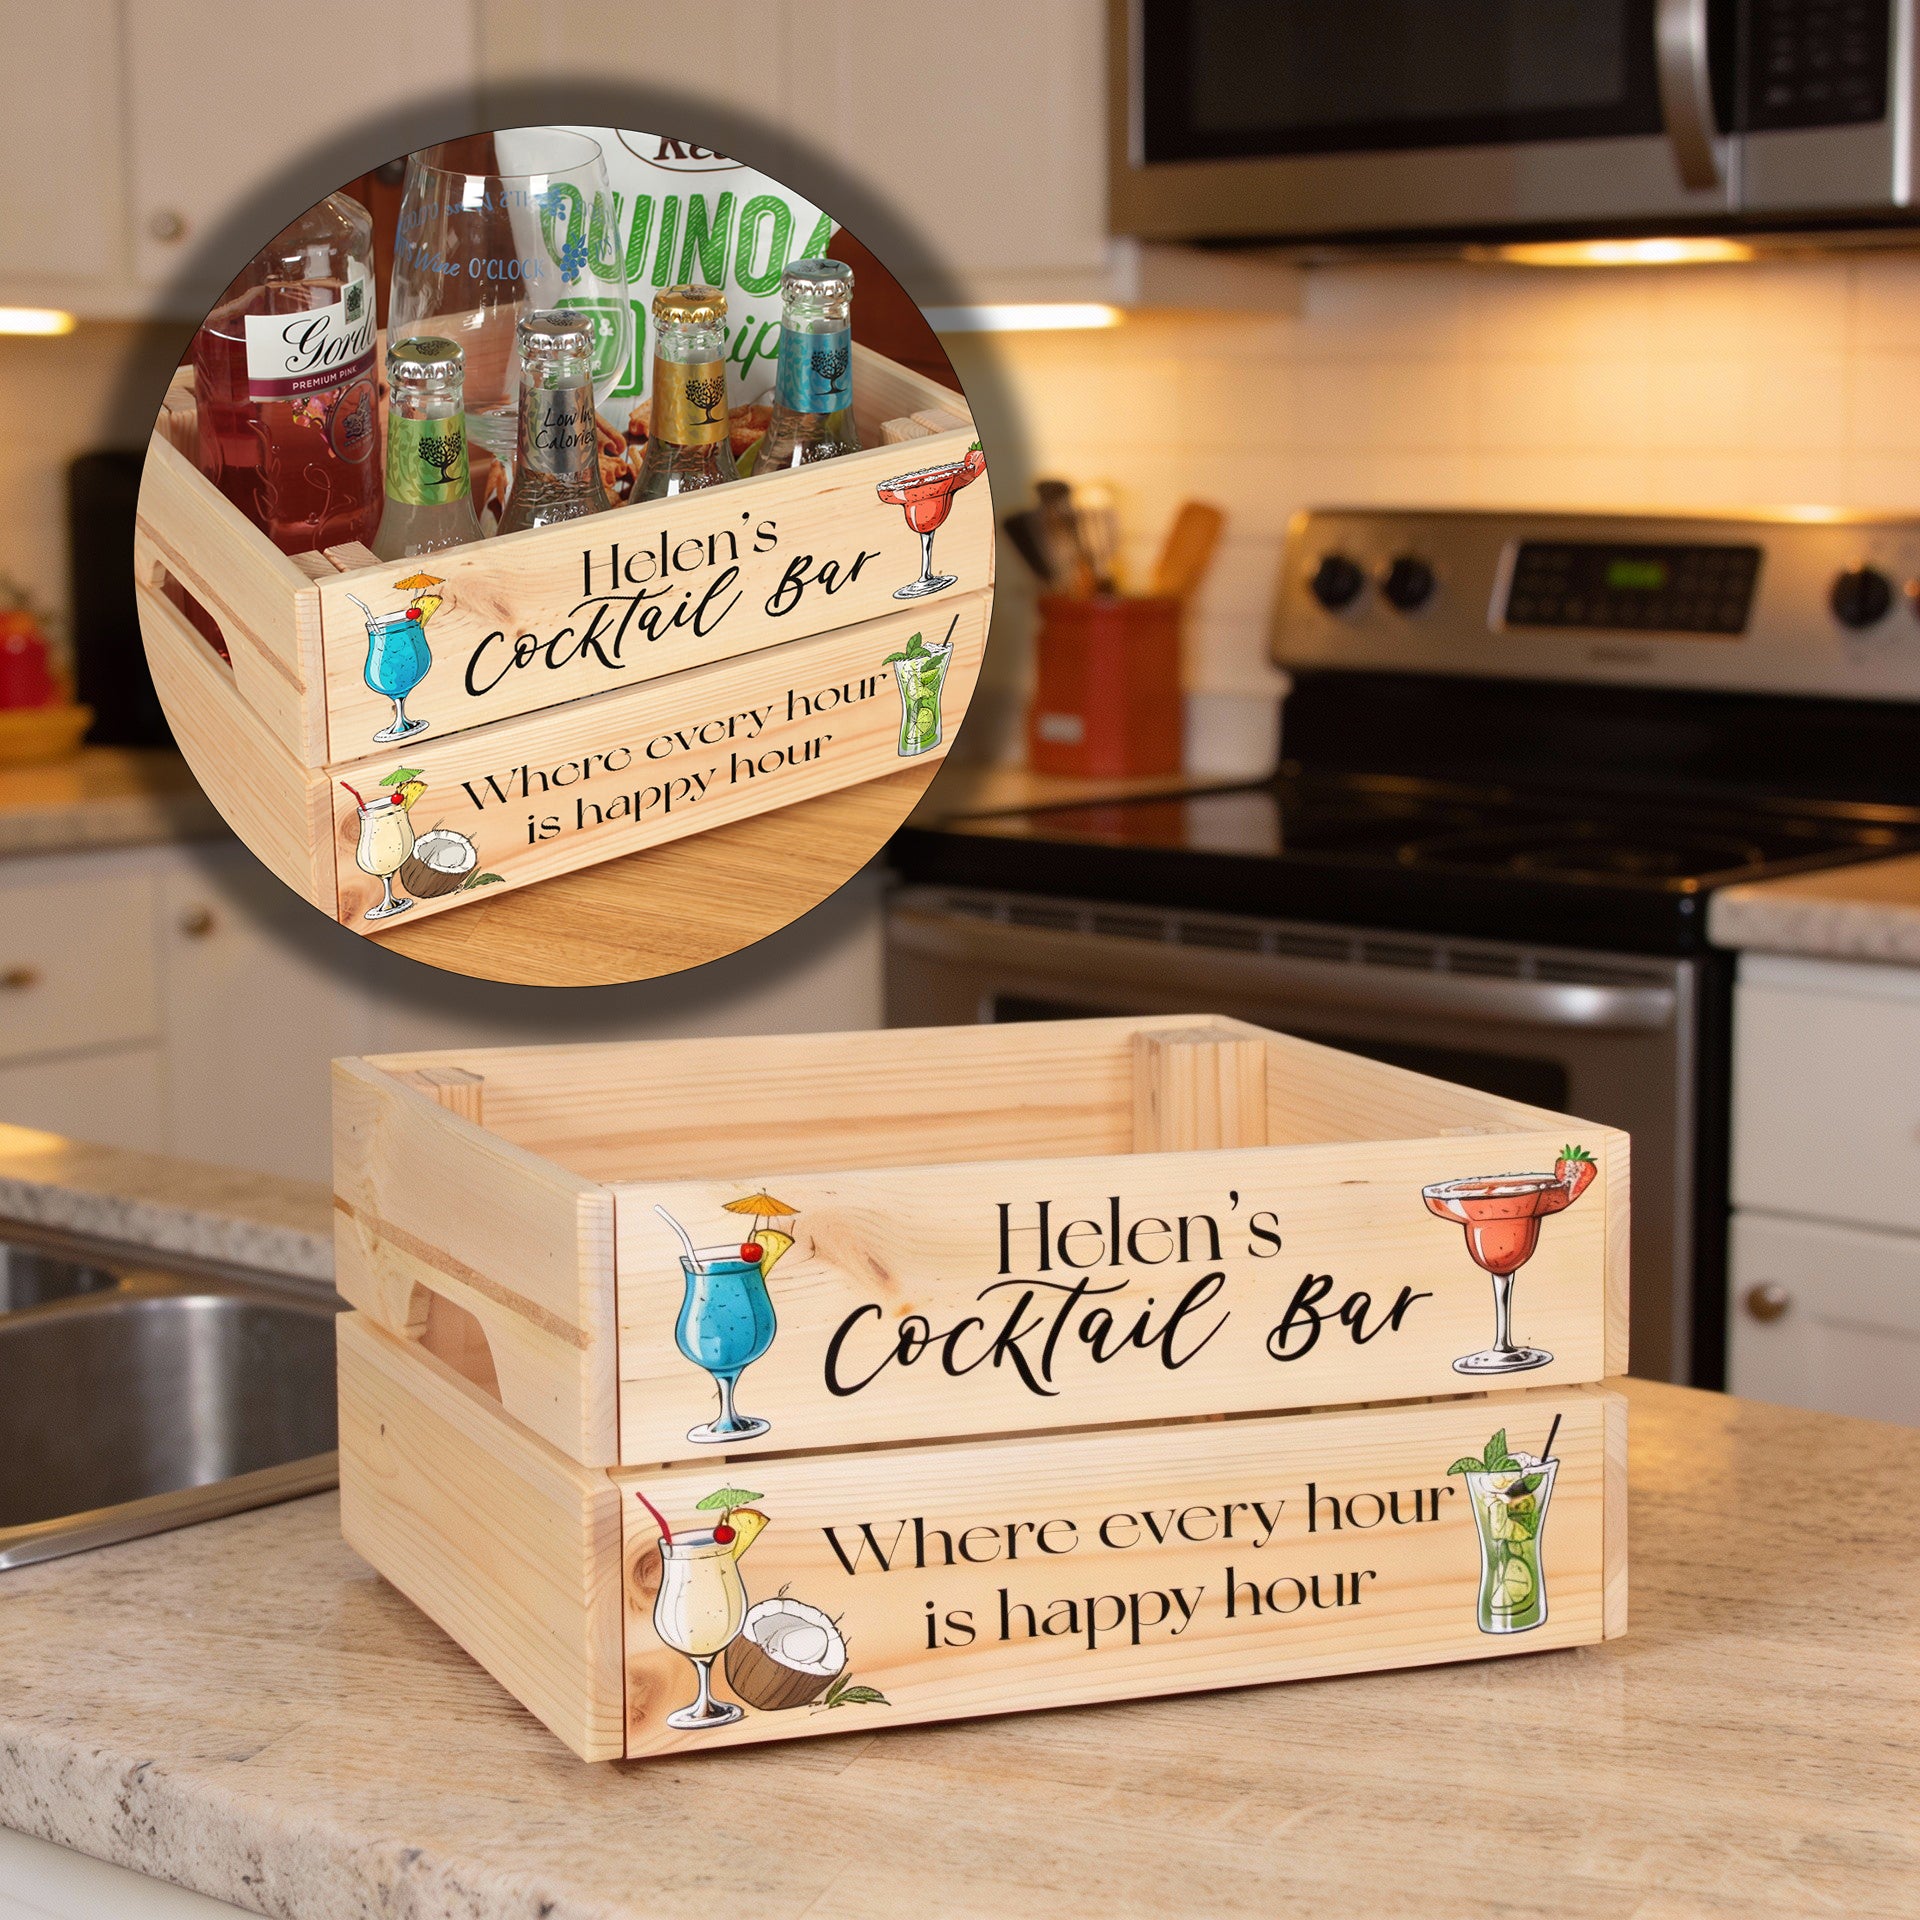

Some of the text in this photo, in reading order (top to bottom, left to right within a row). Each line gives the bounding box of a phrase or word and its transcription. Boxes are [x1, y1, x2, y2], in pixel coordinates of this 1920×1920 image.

[414, 249, 460, 277] Wine
[468, 257, 546, 280] O'CLOCK
[292, 366, 357, 391] PREMIUM PINK
[544, 408, 577, 427] Low
[535, 429, 595, 449] Calories
[583, 512, 777, 596] Helen's
[465, 551, 880, 696] Cocktail Bar
[462, 674, 887, 810] Where every hour
[528, 735, 832, 844] is happy hour
[997, 1191, 1281, 1274] Helen's
[825, 1272, 1434, 1396] Cocktail Bar
[822, 1483, 1454, 1575] Where every hour
[926, 1567, 1376, 1650] is happy hour
